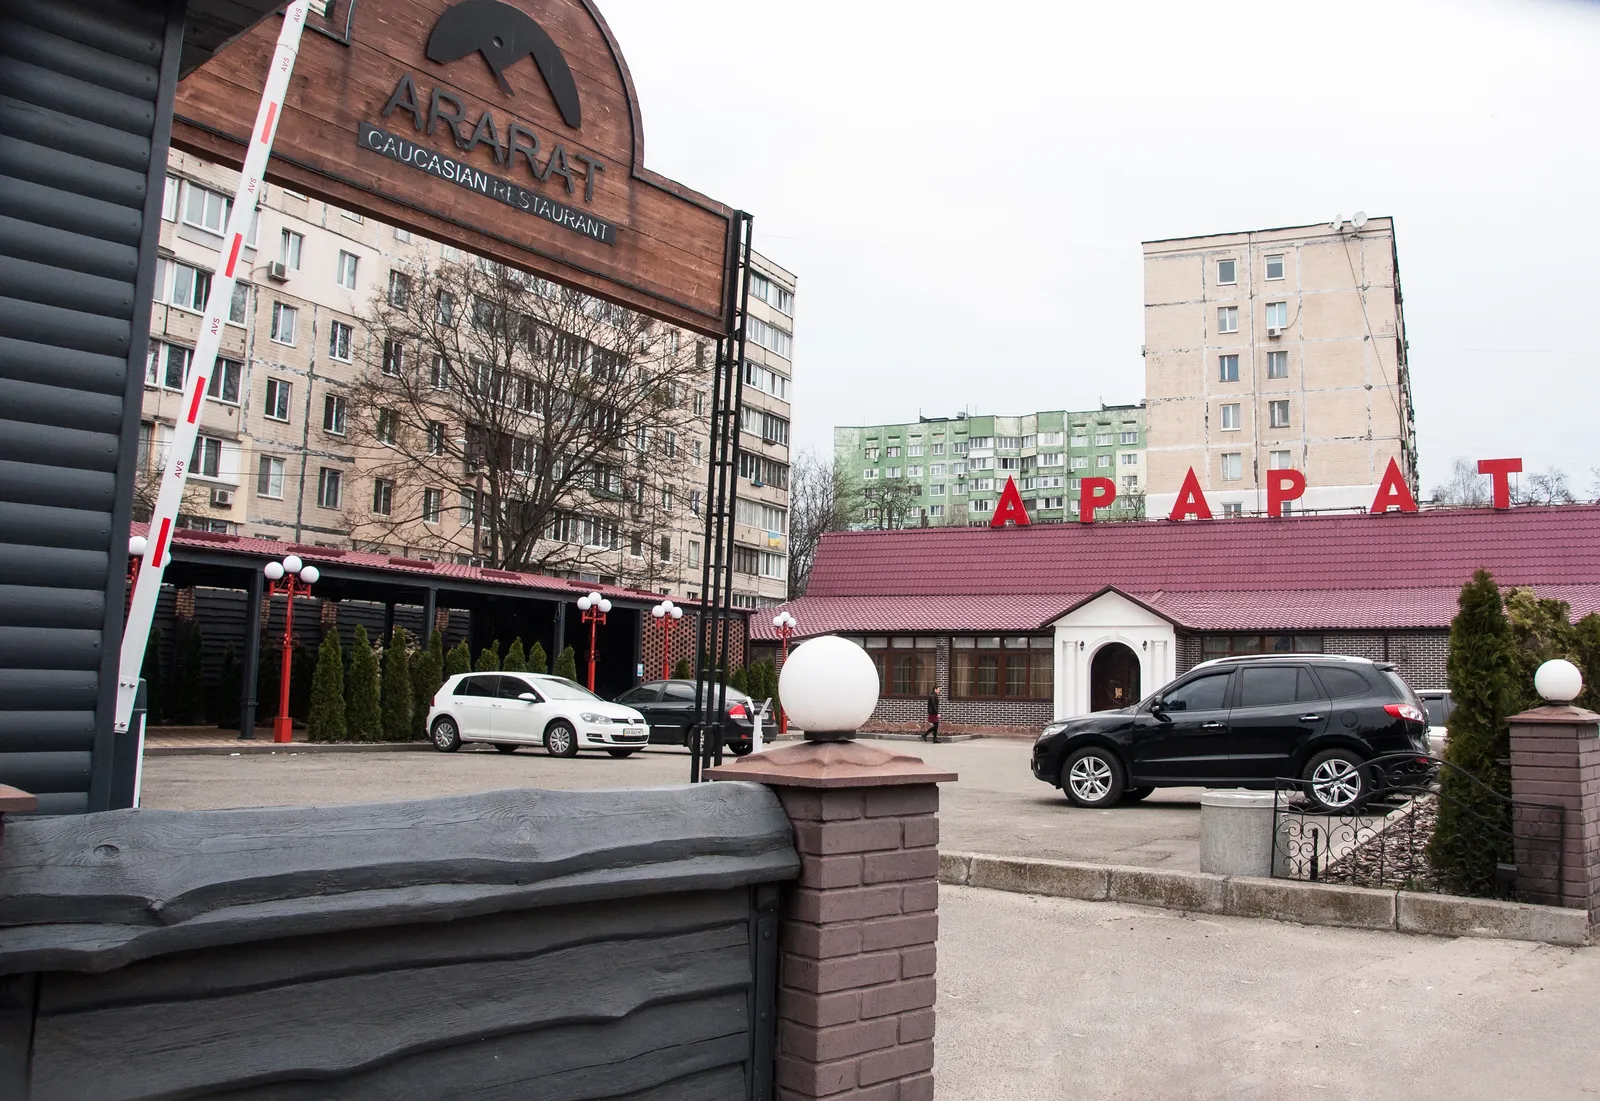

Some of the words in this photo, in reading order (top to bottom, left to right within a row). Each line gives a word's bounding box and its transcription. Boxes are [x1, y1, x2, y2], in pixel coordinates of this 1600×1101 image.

[293, 7, 303, 23] AVS
[281, 56, 290, 73] AVS
[382, 71, 606, 203] ARARAT
[247, 177, 257, 194] AVS
[367, 130, 488, 193] CAUCASIAN
[493, 180, 609, 240] RESTAURANT
[211, 317, 220, 335] AVS
[174, 460, 185, 479] AVS
[991, 457, 1522, 528] АРАРАТ
